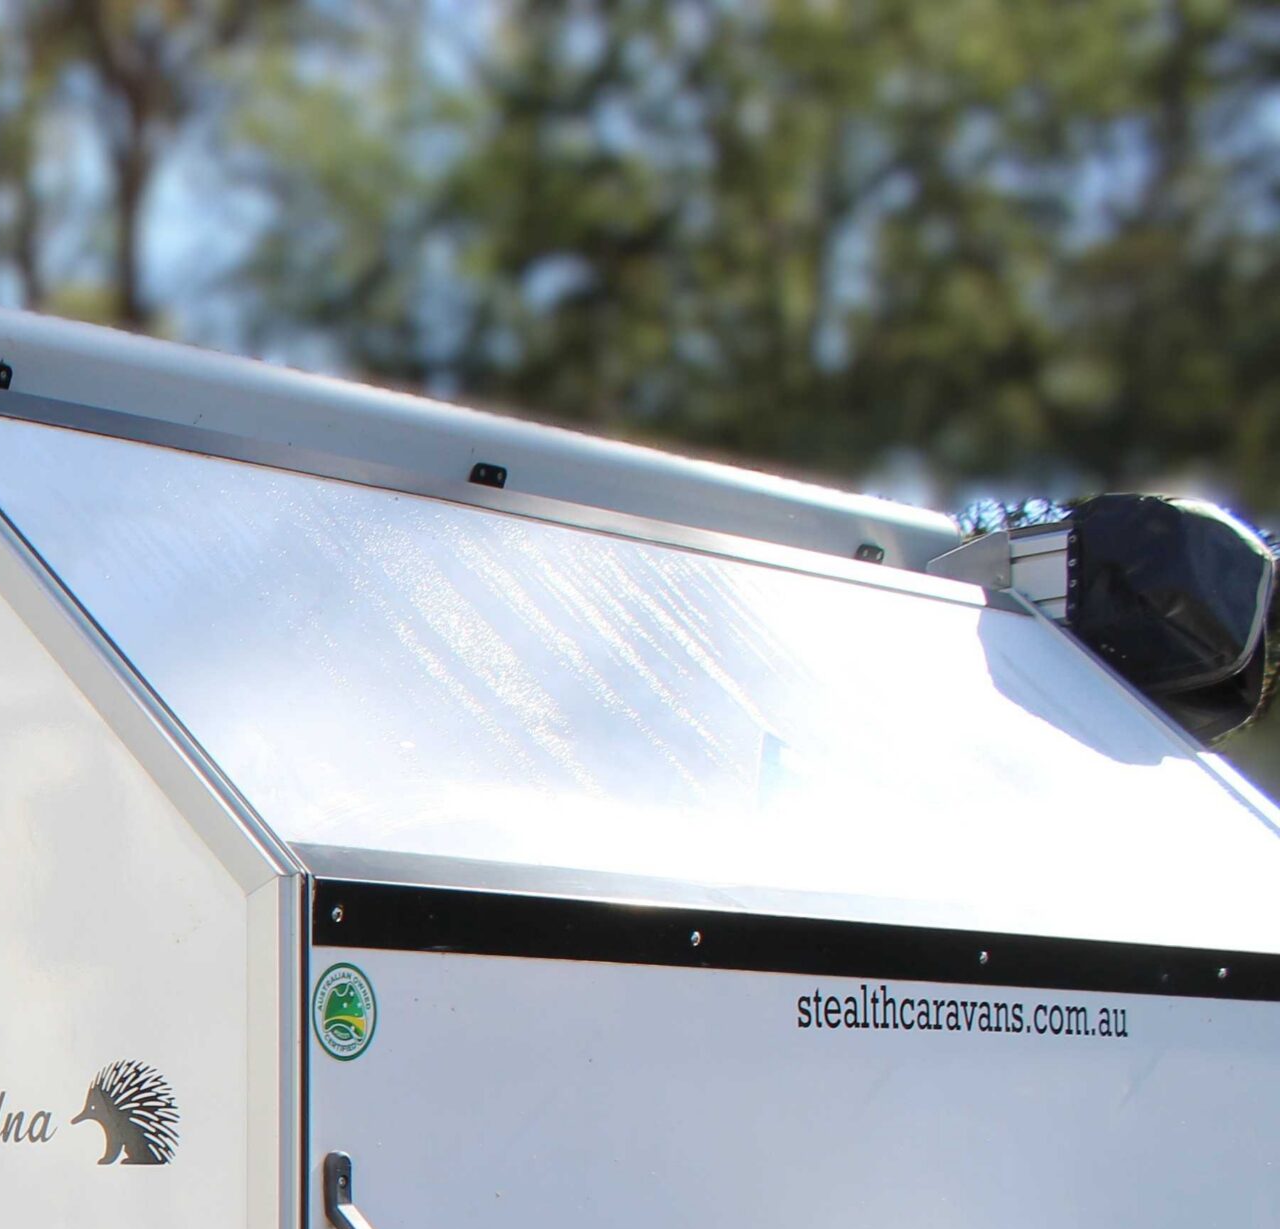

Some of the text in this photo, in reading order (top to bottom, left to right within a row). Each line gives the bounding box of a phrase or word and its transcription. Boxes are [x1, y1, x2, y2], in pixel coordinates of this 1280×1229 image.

[317, 971, 371, 1011] AUSTRALIAN OWNED
[797, 984, 1129, 1038] stealthcaravans.com.au
